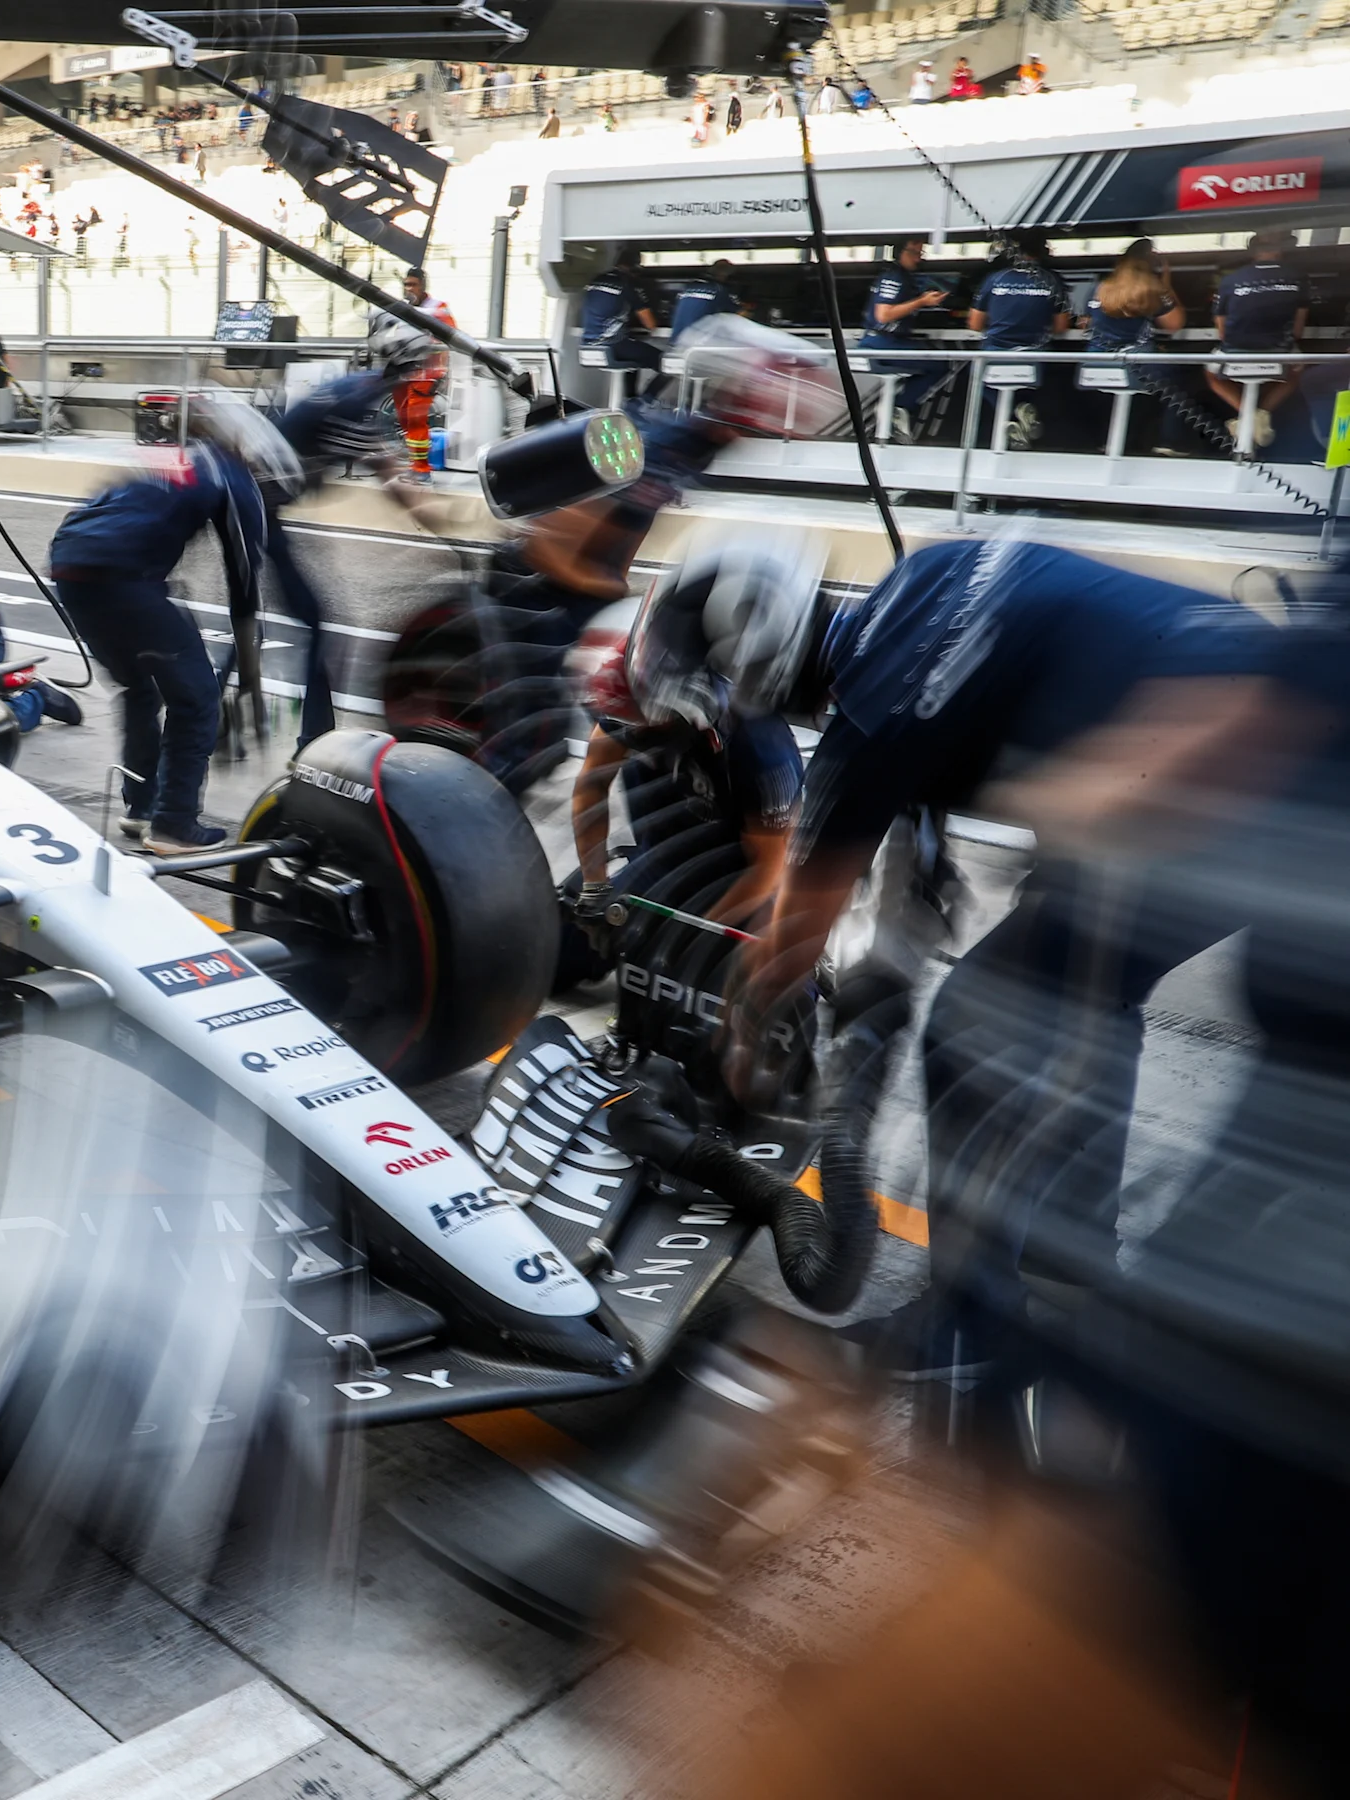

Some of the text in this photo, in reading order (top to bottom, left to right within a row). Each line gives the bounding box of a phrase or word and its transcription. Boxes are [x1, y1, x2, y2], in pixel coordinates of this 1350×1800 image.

[1229, 172, 1306, 194] ORLEN
[6, 823, 80, 865] 3
[152, 951, 246, 987] FLEXBOX
[207, 1000, 295, 1030] RAVENOL
[296, 1076, 388, 1111] PIRELLI
[385, 1147, 455, 1176] ORLEN
